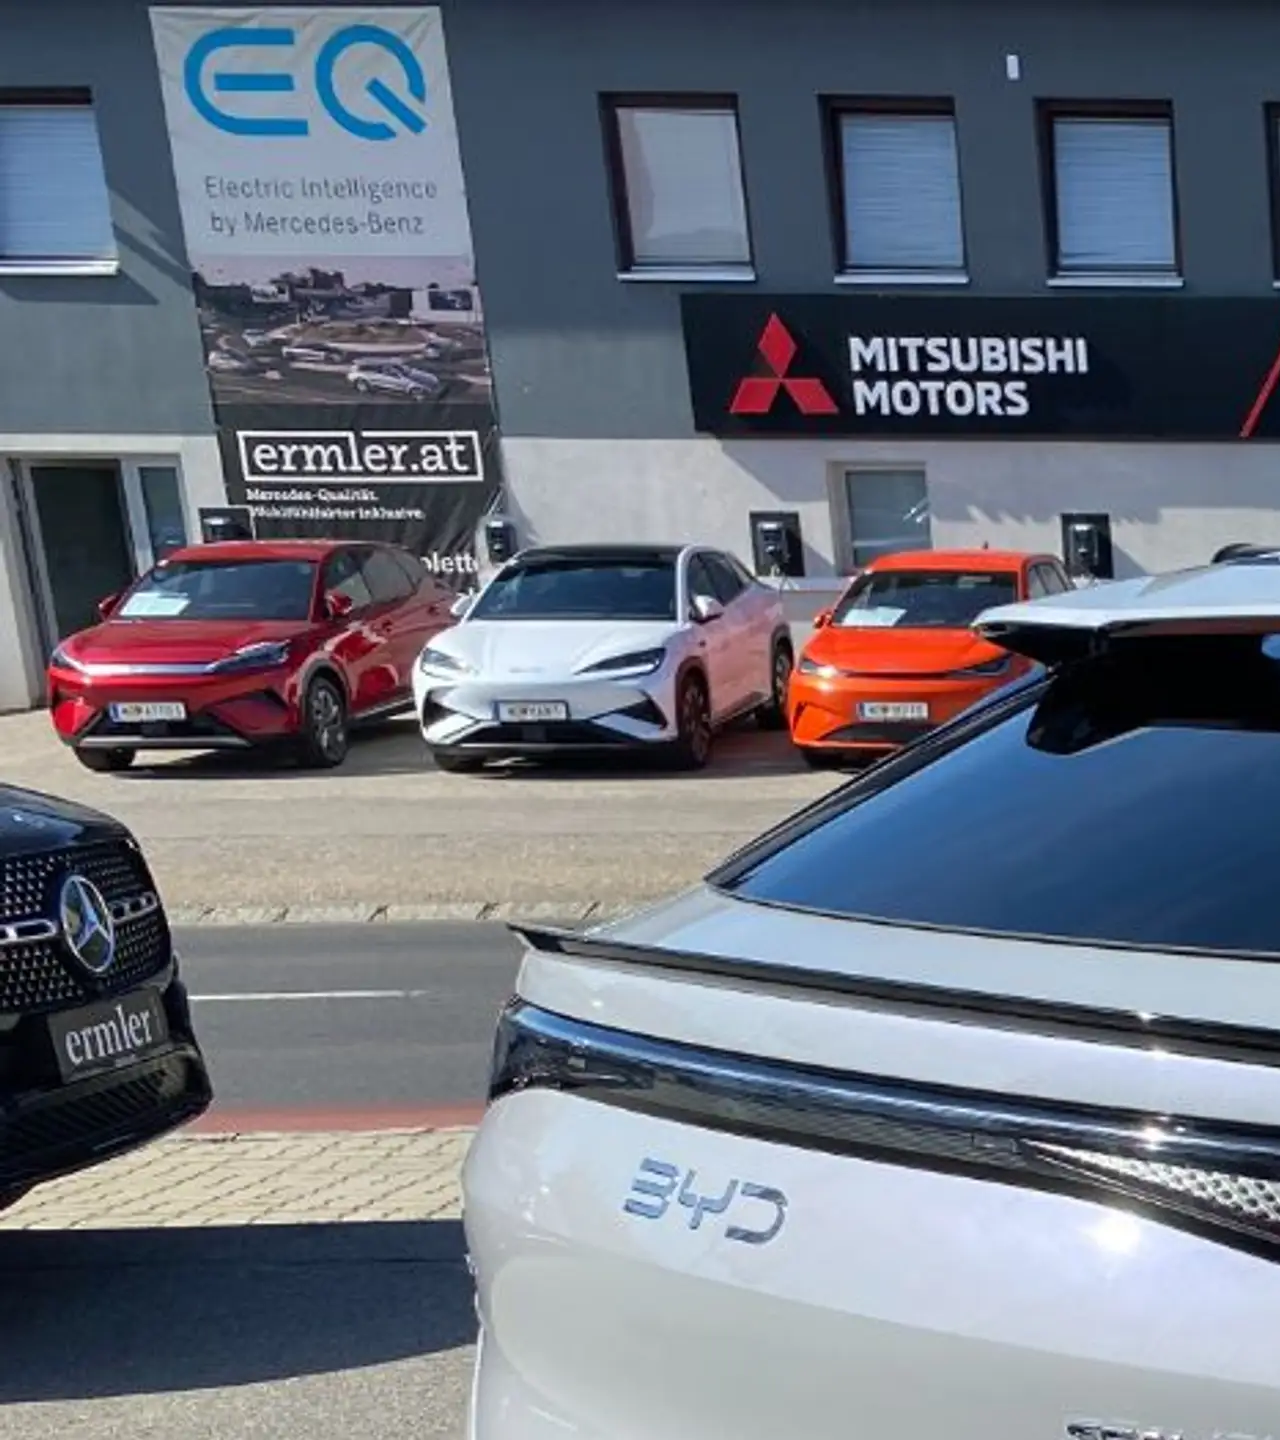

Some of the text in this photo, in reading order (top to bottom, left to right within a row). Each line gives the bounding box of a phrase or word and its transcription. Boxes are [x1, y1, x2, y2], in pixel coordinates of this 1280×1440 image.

[184, 24, 427, 141] EQ
[204, 176, 438, 204] Electric Intelligence
[211, 212, 424, 236] by Mercedes-Benz
[849, 336, 1089, 373] MITSUBISHI
[853, 379, 1029, 416] MOTORS
[253, 433, 470, 472] ermler.at
[65, 1003, 152, 1065] ermler
[623, 1157, 790, 1246] BYD
